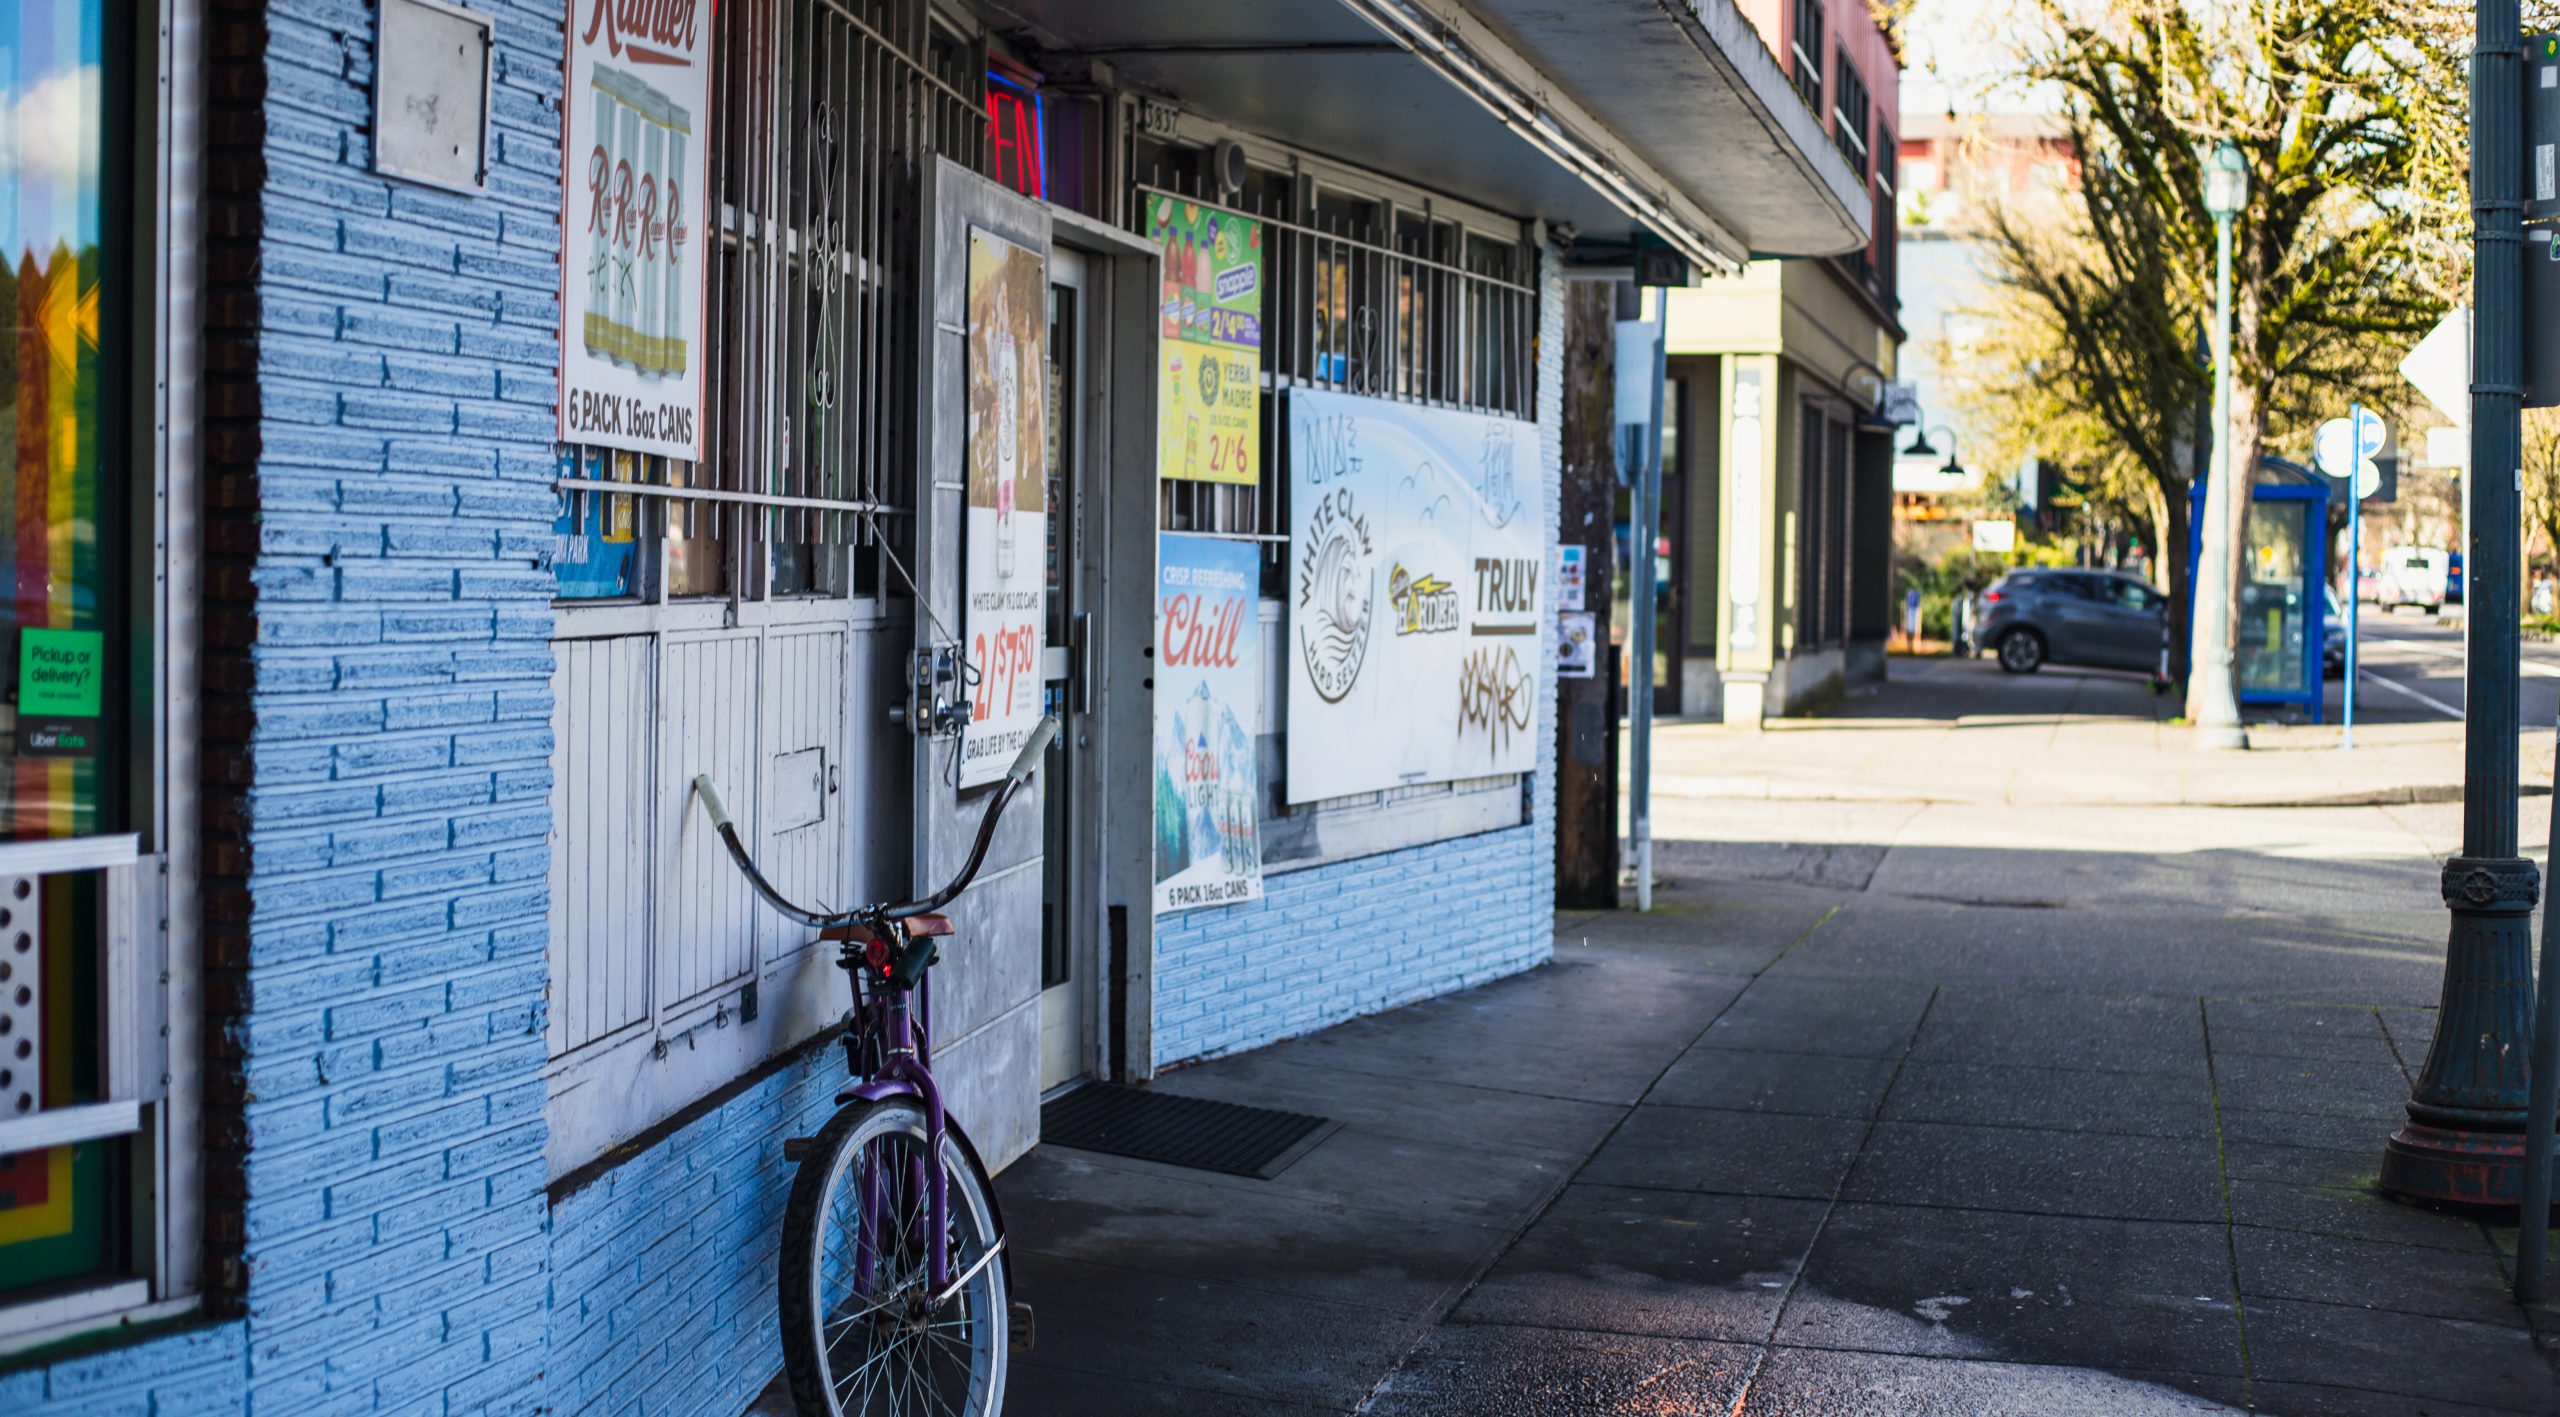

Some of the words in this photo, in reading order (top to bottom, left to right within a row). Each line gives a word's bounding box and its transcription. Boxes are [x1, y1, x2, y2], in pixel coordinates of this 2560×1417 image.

[569, 387, 578, 430] 6
[582, 389, 622, 435] PACK
[626, 397, 656, 439] 16oz
[659, 402, 692, 445] CANS
[1300, 492, 1334, 609] WHITE
[1338, 487, 1372, 556] CLAW
[1475, 558, 1538, 612] TRULY
[973, 592, 989, 611] WHITE
[991, 592, 1005, 611] CLAW
[1024, 592, 1038, 610] CANS
[1162, 592, 1246, 668] Chill
[31, 645, 75, 667] Pickup
[77, 651, 91, 664] or
[1309, 640, 1333, 691] HARD
[31, 667, 91, 688] delivery?
[30, 733, 57, 748] Uber
[58, 733, 85, 749] Eats
[967, 737, 984, 760] GRAB
[985, 734, 997, 756] LIFE
[998, 732, 1006, 753] BY
[1006, 730, 1017, 751] THE
[1188, 783, 1219, 808] LIGHT
[1169, 888, 1176, 906] 6
[1177, 884, 1202, 905] PACK
[1225, 880, 1248, 899] CANS
